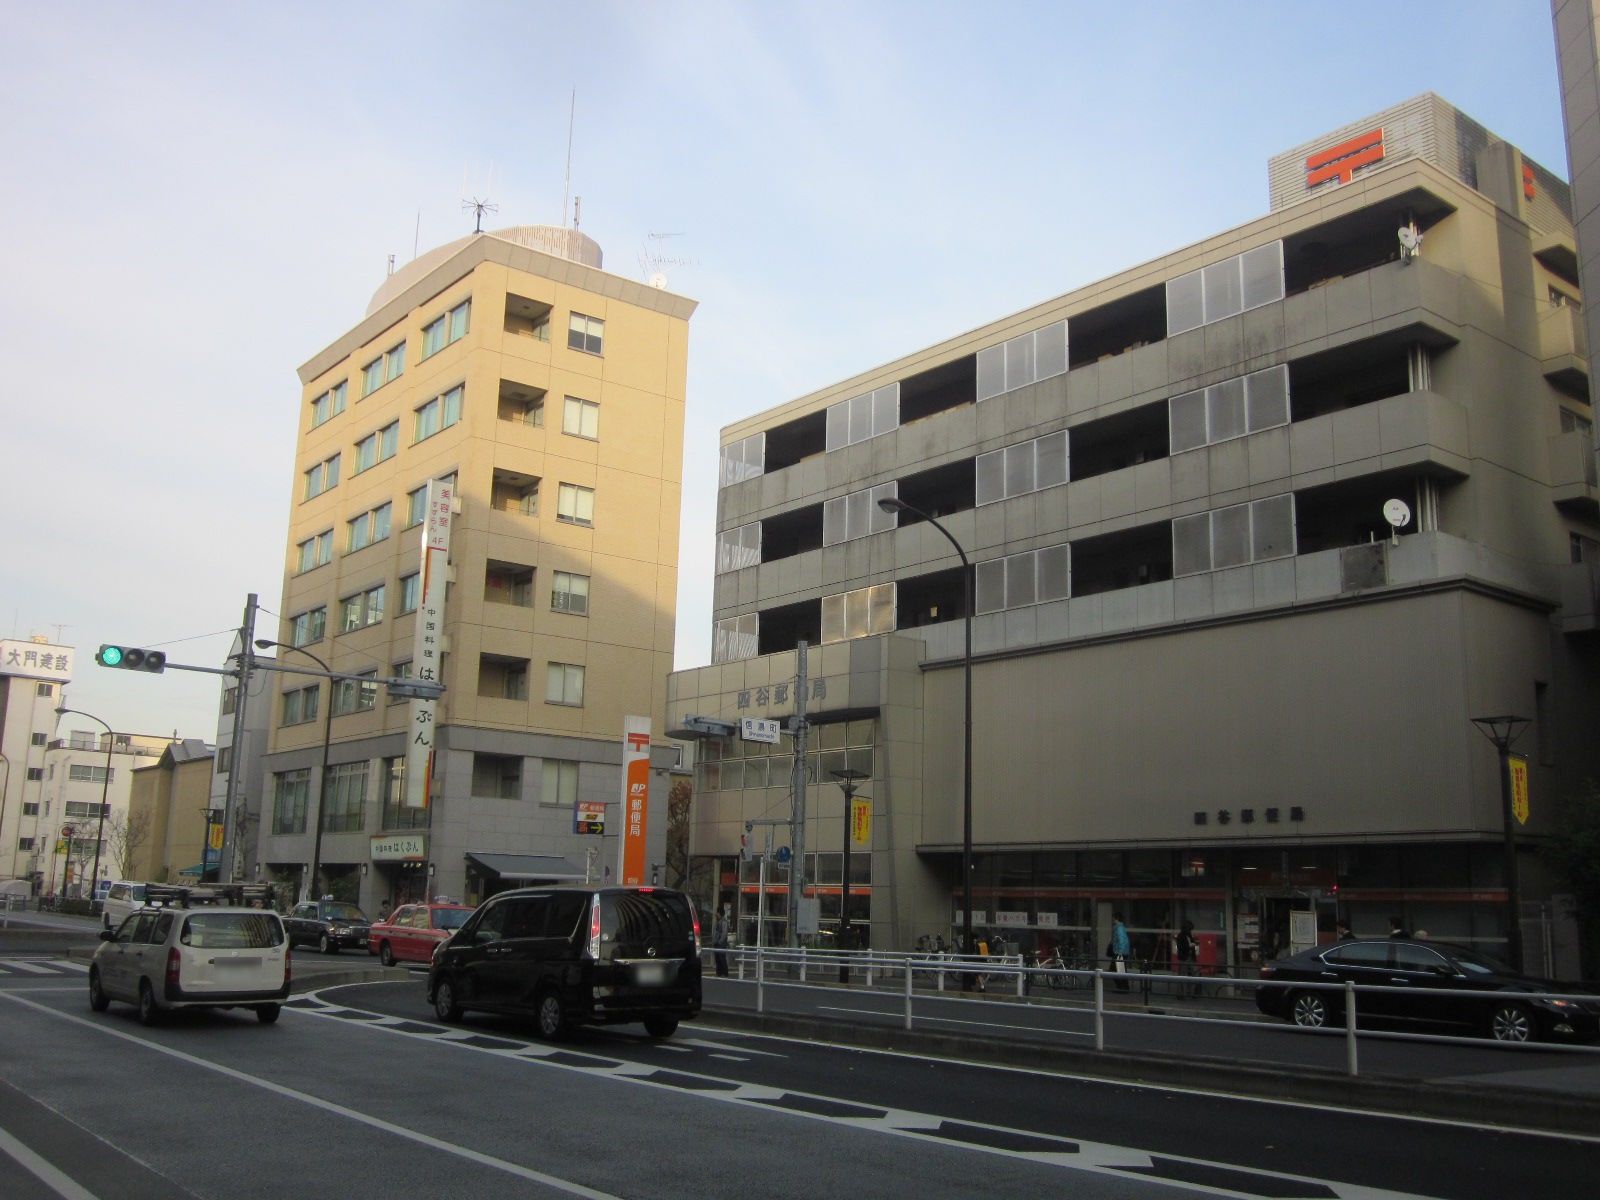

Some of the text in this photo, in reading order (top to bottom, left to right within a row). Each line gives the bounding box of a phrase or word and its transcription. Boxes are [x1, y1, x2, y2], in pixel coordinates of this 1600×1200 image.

[439, 488, 450, 528] 美容室
[432, 537, 443, 545] 4F
[423, 608, 436, 659] 中国料理
[6, 648, 69, 672] 大門建設
[414, 667, 434, 746] はぶん
[737, 679, 827, 710] 四谷郵局
[630, 799, 643, 837] 郵便局
